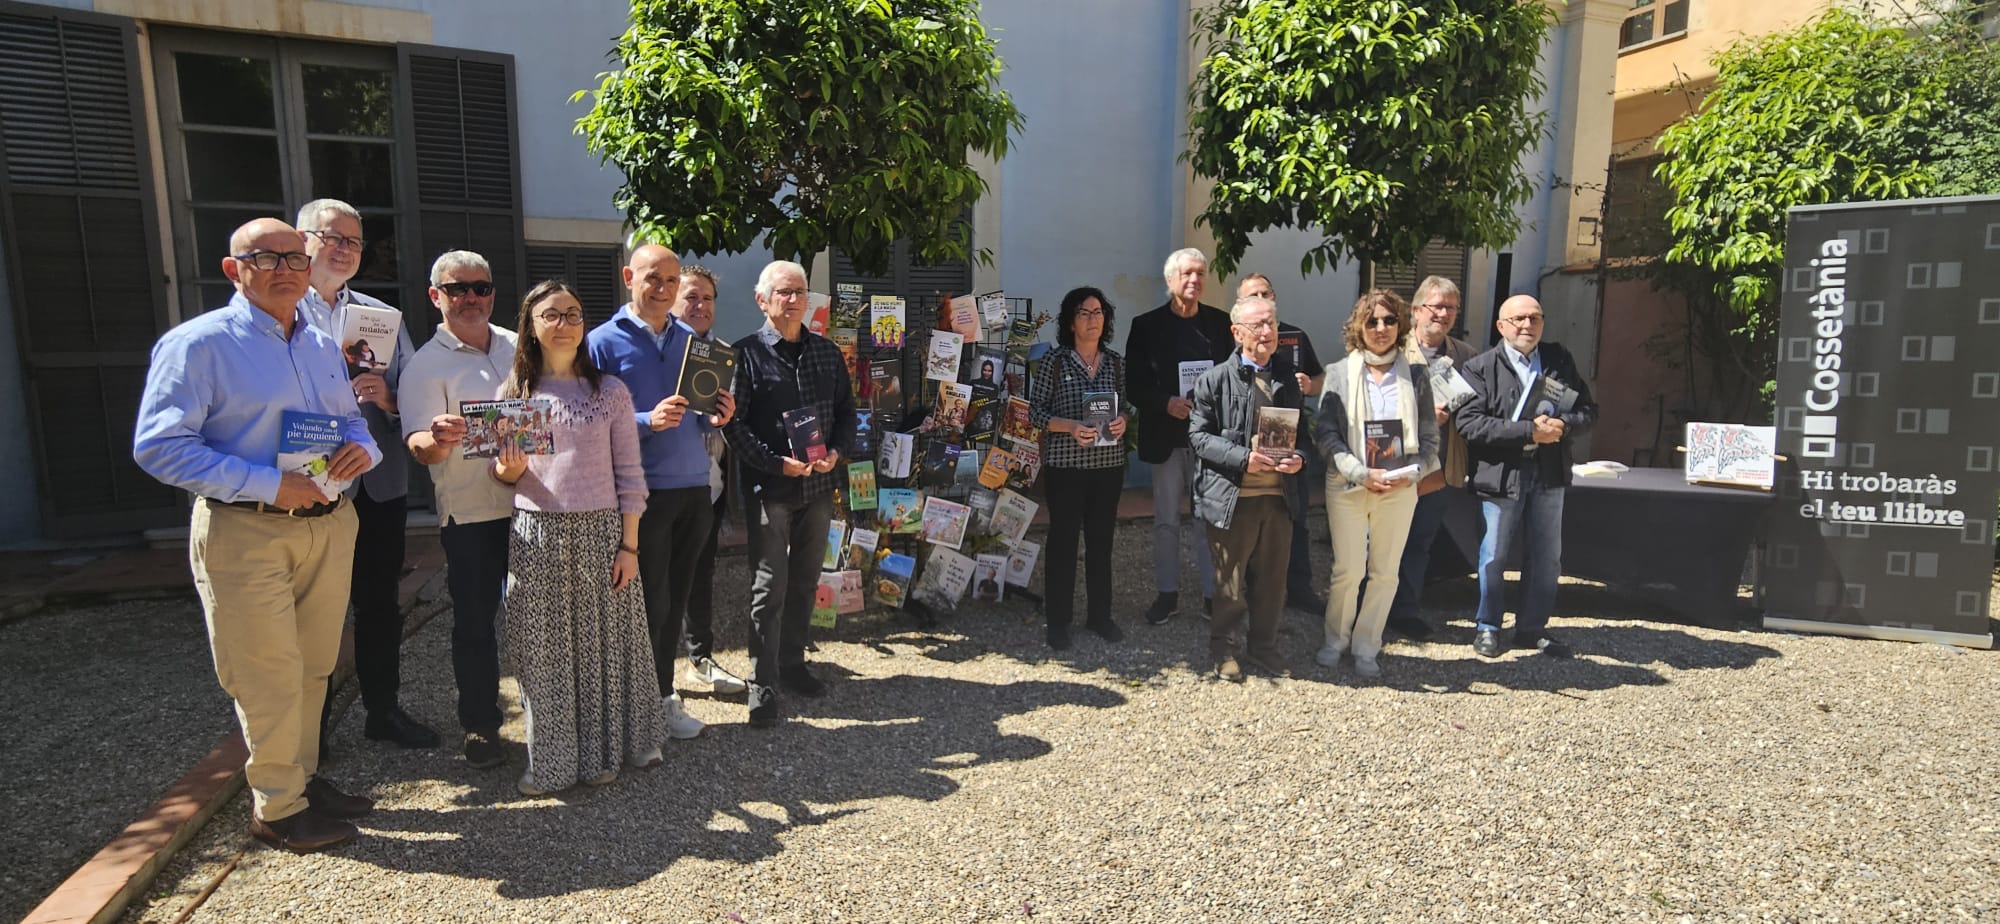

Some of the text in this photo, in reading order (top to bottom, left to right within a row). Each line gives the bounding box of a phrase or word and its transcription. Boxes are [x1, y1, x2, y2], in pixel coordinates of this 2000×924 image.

[359, 326, 394, 335] música?
[1805, 238, 1848, 412] Cossetània
[287, 430, 343, 441] pie izquierdo
[292, 422, 323, 432] Volando
[1801, 470, 1957, 495] Hi trobaràs
[1800, 499, 1965, 525] el teu llibre
